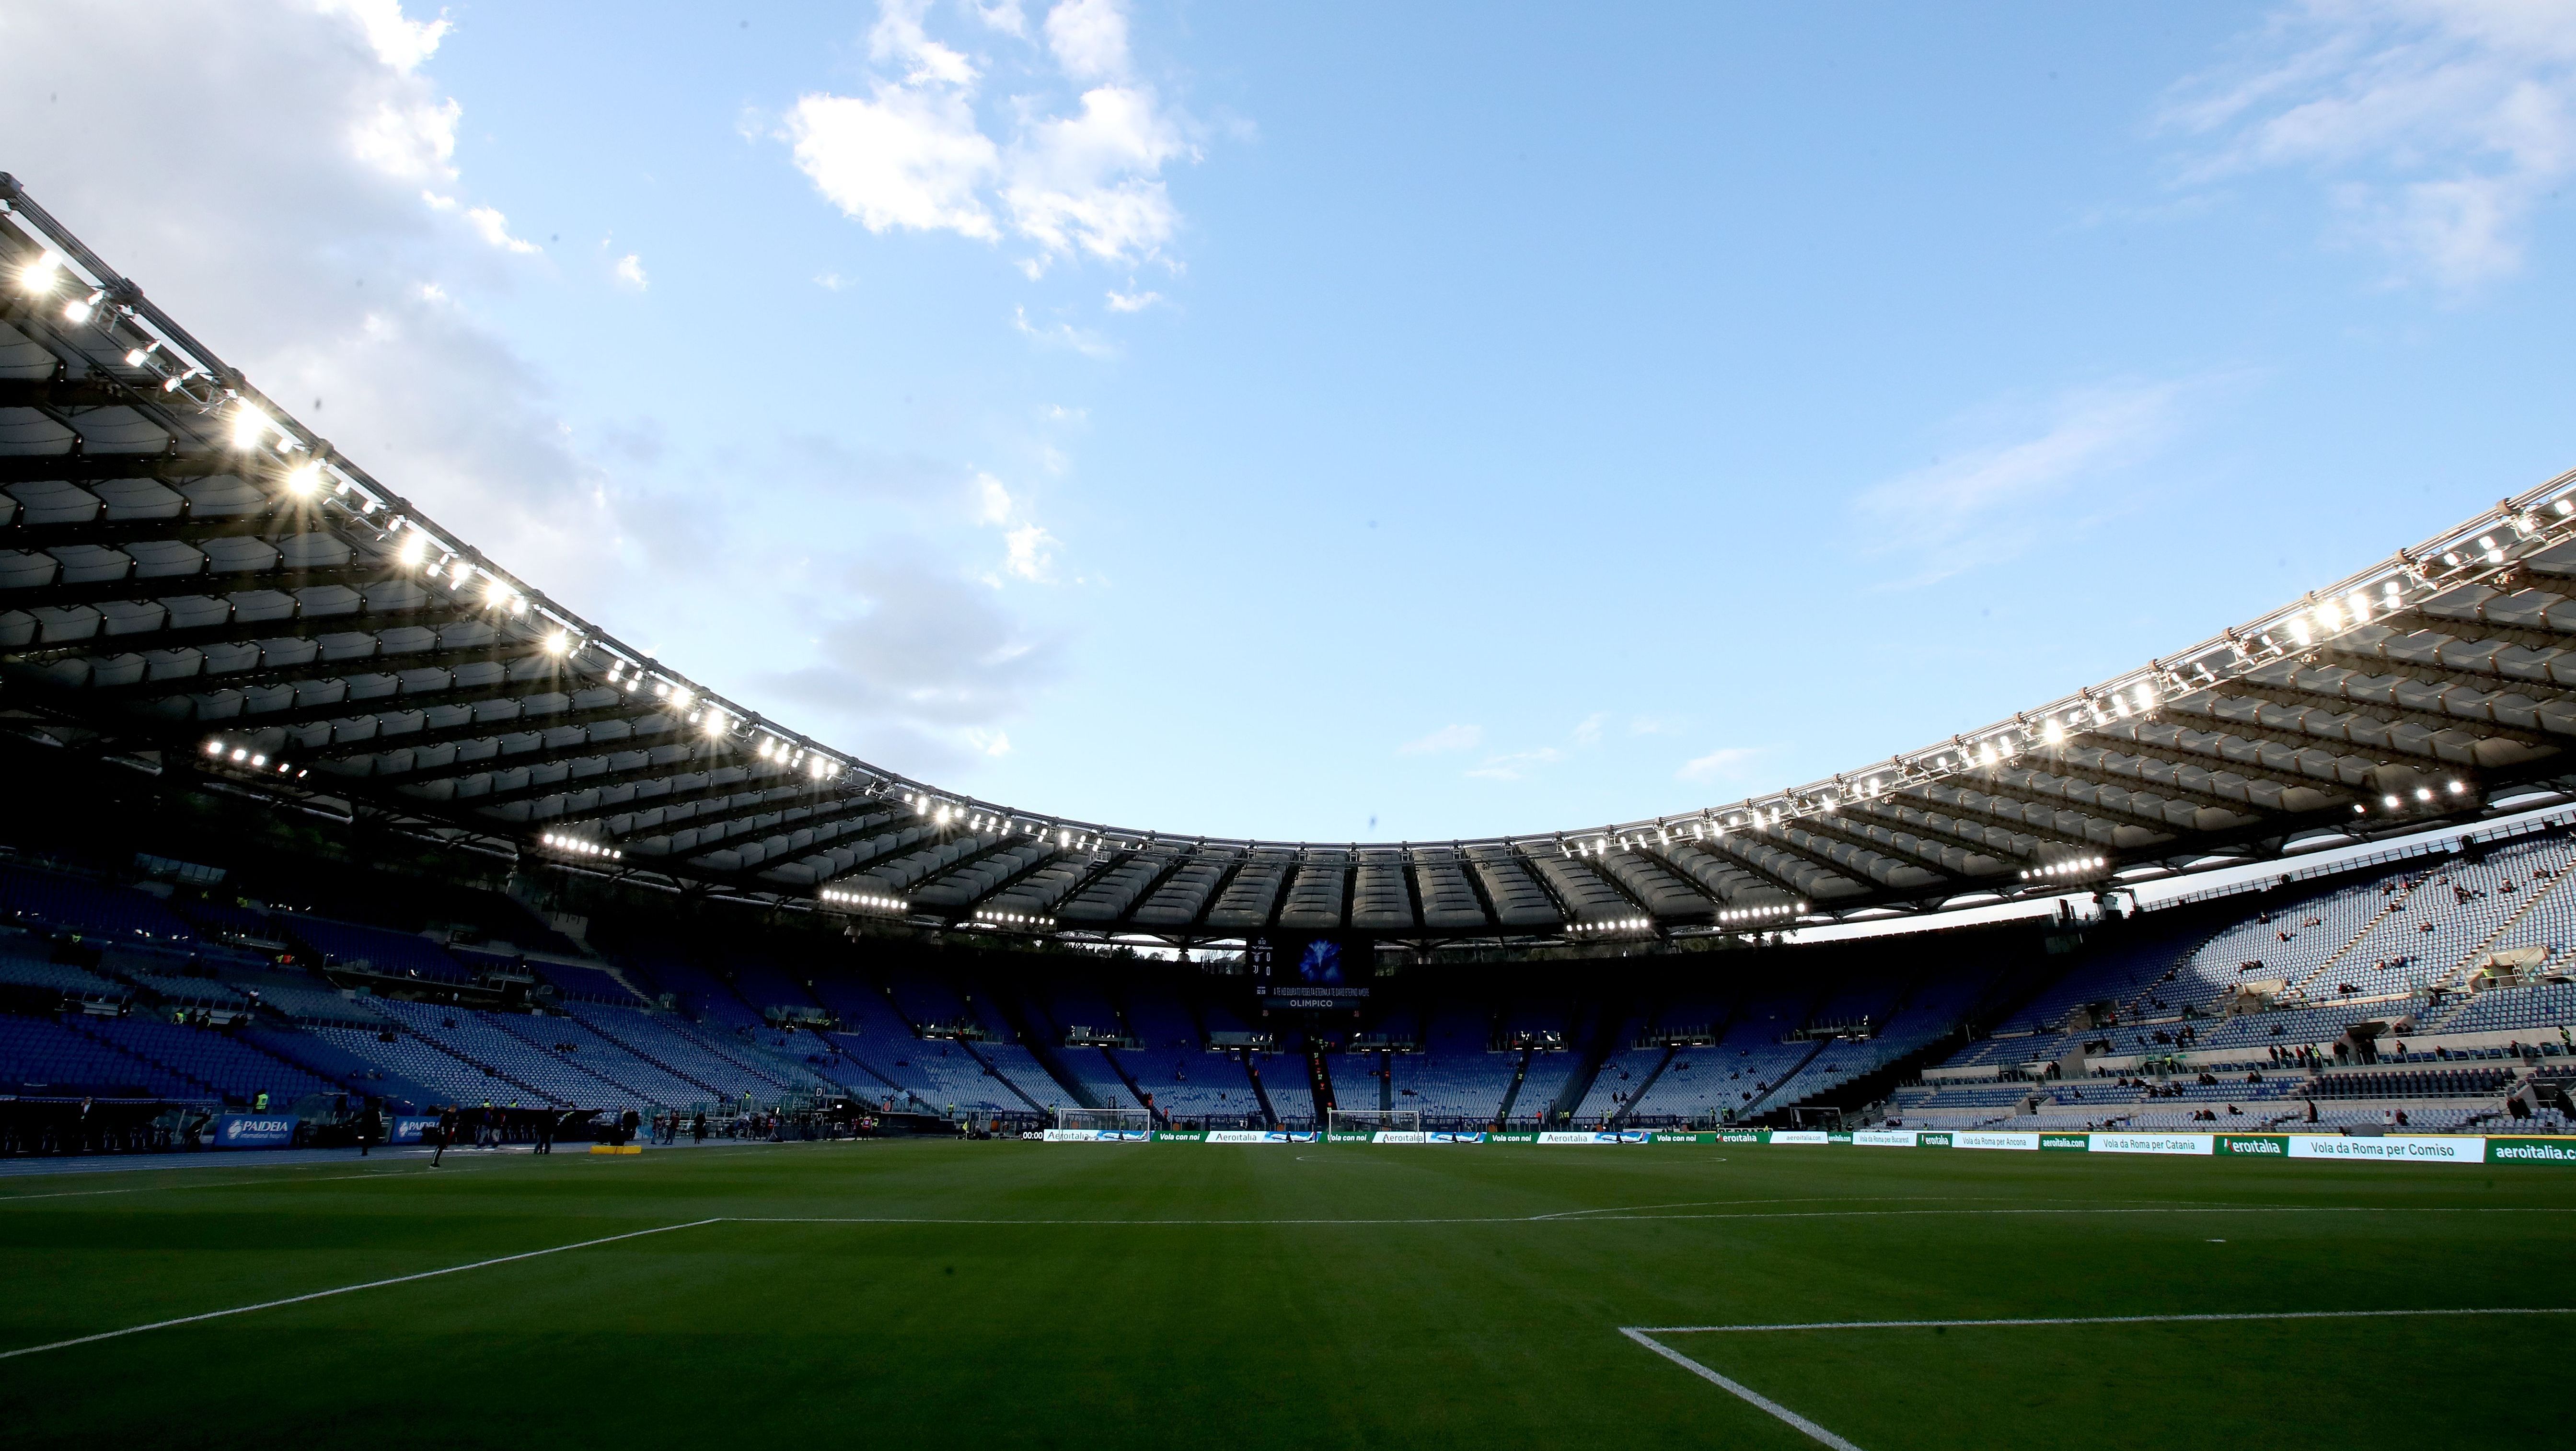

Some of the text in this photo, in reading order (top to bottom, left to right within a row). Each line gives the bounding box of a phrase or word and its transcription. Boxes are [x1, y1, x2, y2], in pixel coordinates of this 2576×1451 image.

[1267, 952, 1271, 962] 0
[1266, 966, 1270, 976] 0
[1277, 987, 1281, 996] TE
[816, 1088, 822, 1096] D
[243, 1121, 288, 1131] PAIDEIA
[1716, 1134, 1757, 1142] Aeroitalia
[1962, 1137, 1974, 1145] Vola
[1982, 1138, 1996, 1146] Roma
[2007, 1138, 2027, 1146] Ancona
[2043, 1138, 2085, 1148] aeroitalia.com
[2103, 1139, 2195, 1151] Vola da Roma per Catania
[2224, 1138, 2282, 1153] Aeroitalia
[2310, 1141, 2455, 1158] Vola da Roma per Comiso
[2496, 1144, 2576, 1160] aeroitalia.c
